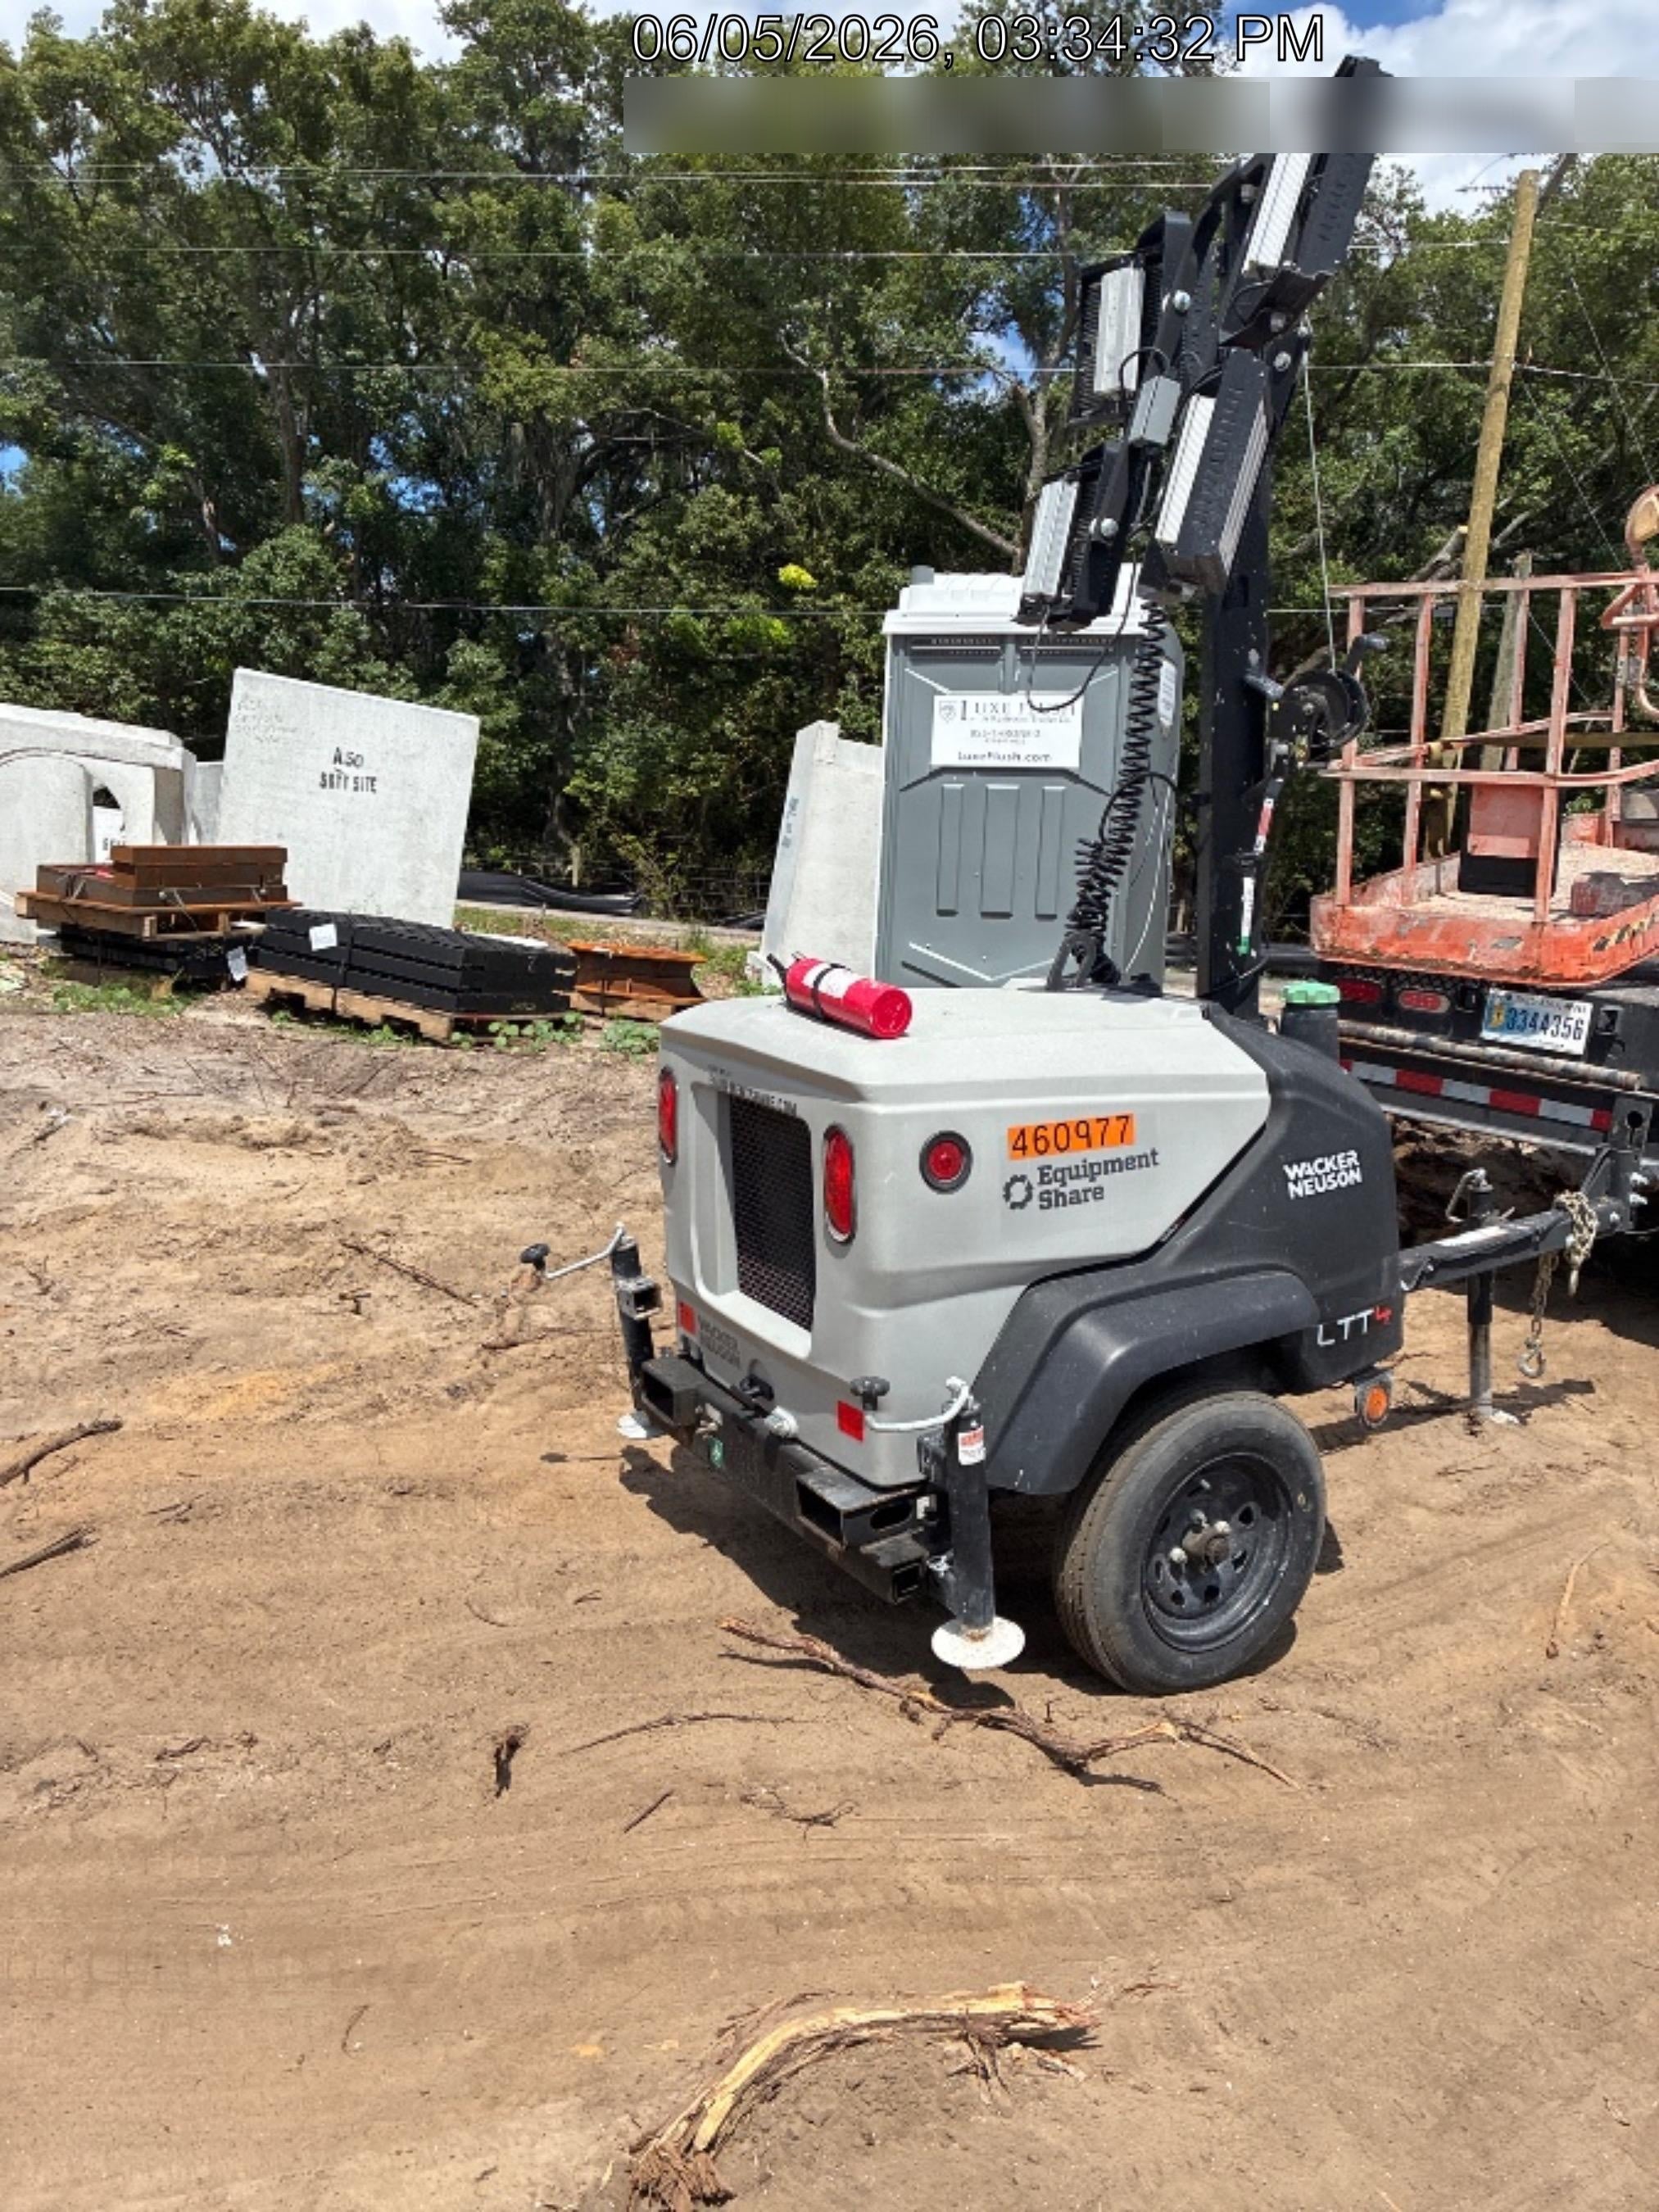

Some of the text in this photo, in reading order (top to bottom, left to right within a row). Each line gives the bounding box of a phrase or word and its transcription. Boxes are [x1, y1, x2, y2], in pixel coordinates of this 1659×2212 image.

[1012, 1115, 1131, 1156] 460977
[1036, 1148, 1160, 1187] Equipment
[1283, 1149, 1360, 1181] WACKER
[1038, 1186, 1104, 1210] Share
[1288, 1167, 1362, 1199] NEUSON
